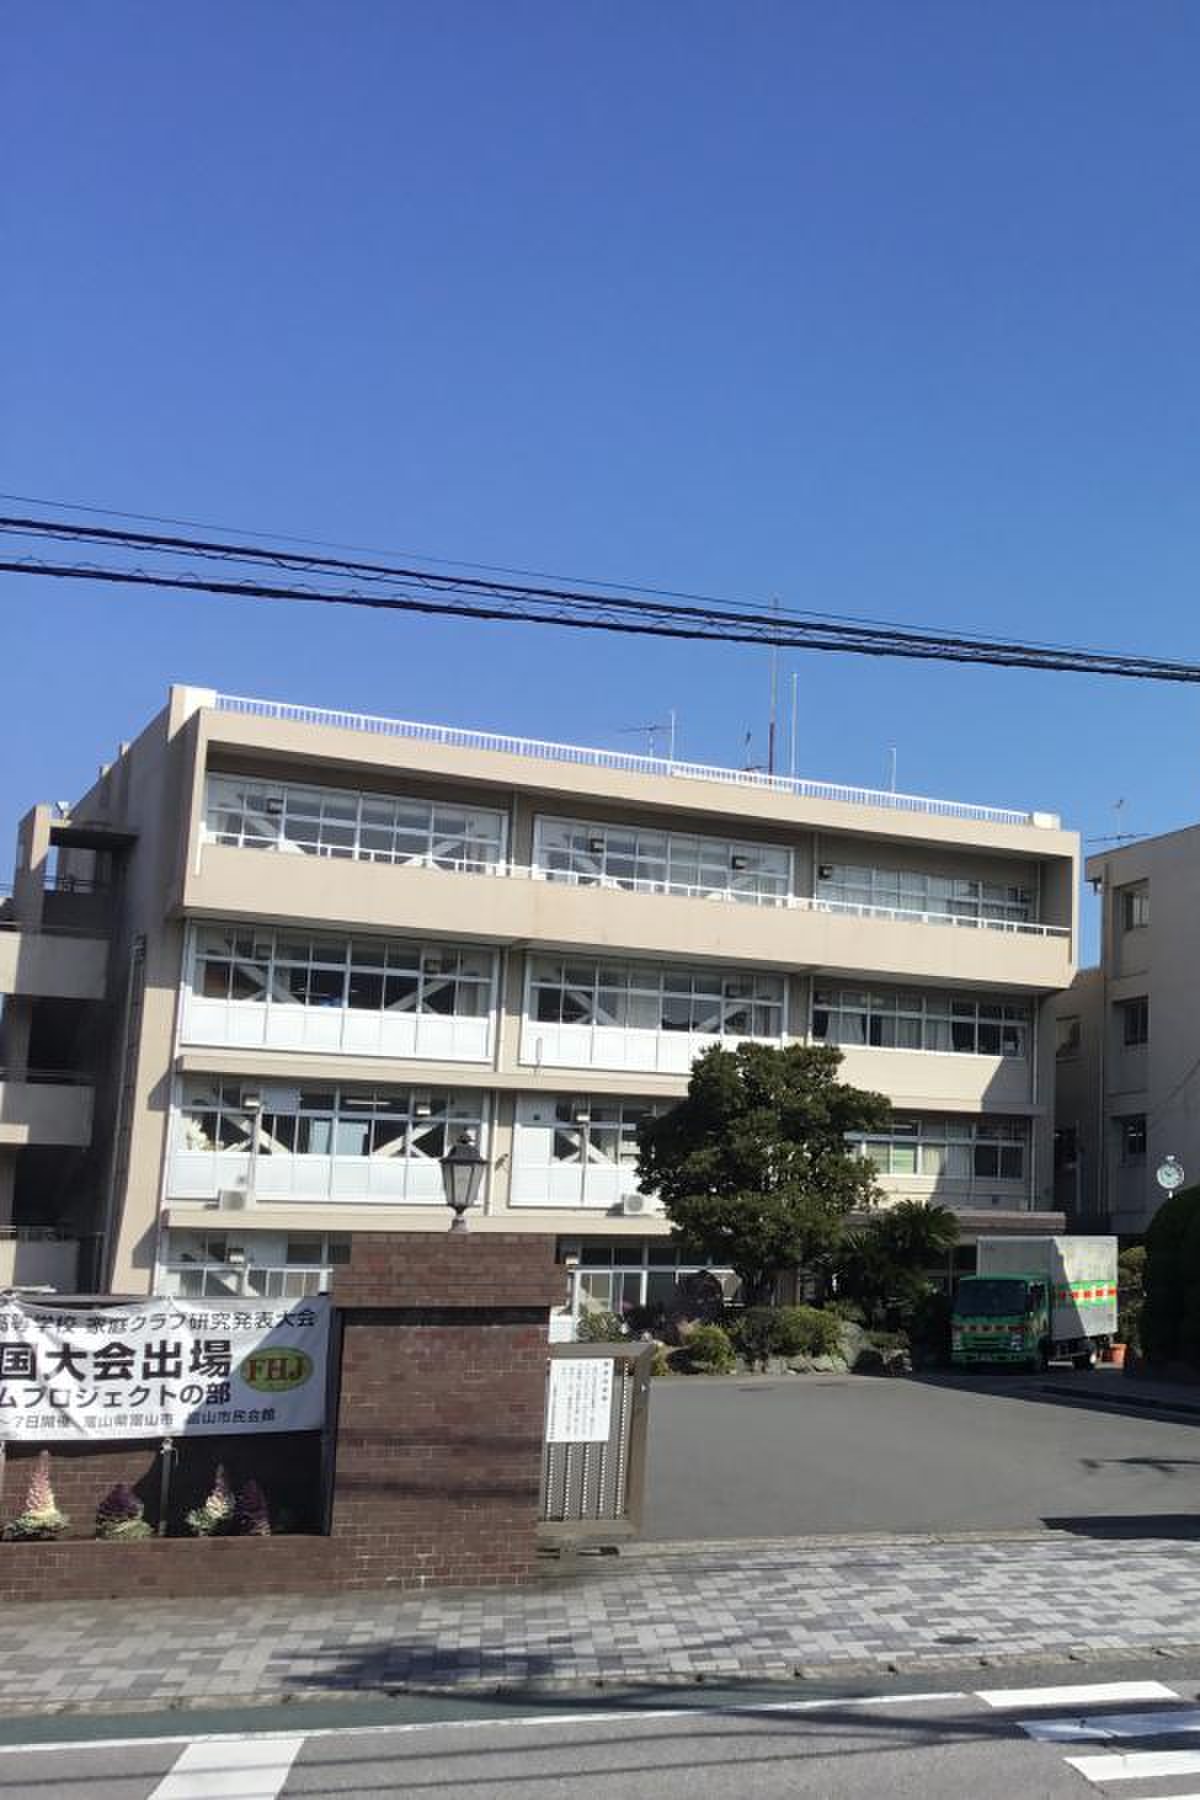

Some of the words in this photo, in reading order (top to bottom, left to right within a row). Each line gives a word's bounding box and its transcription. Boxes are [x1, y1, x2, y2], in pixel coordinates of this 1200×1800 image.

[0, 1340, 232, 1382] 国大会出場
[249, 1357, 306, 1381] FHJ
